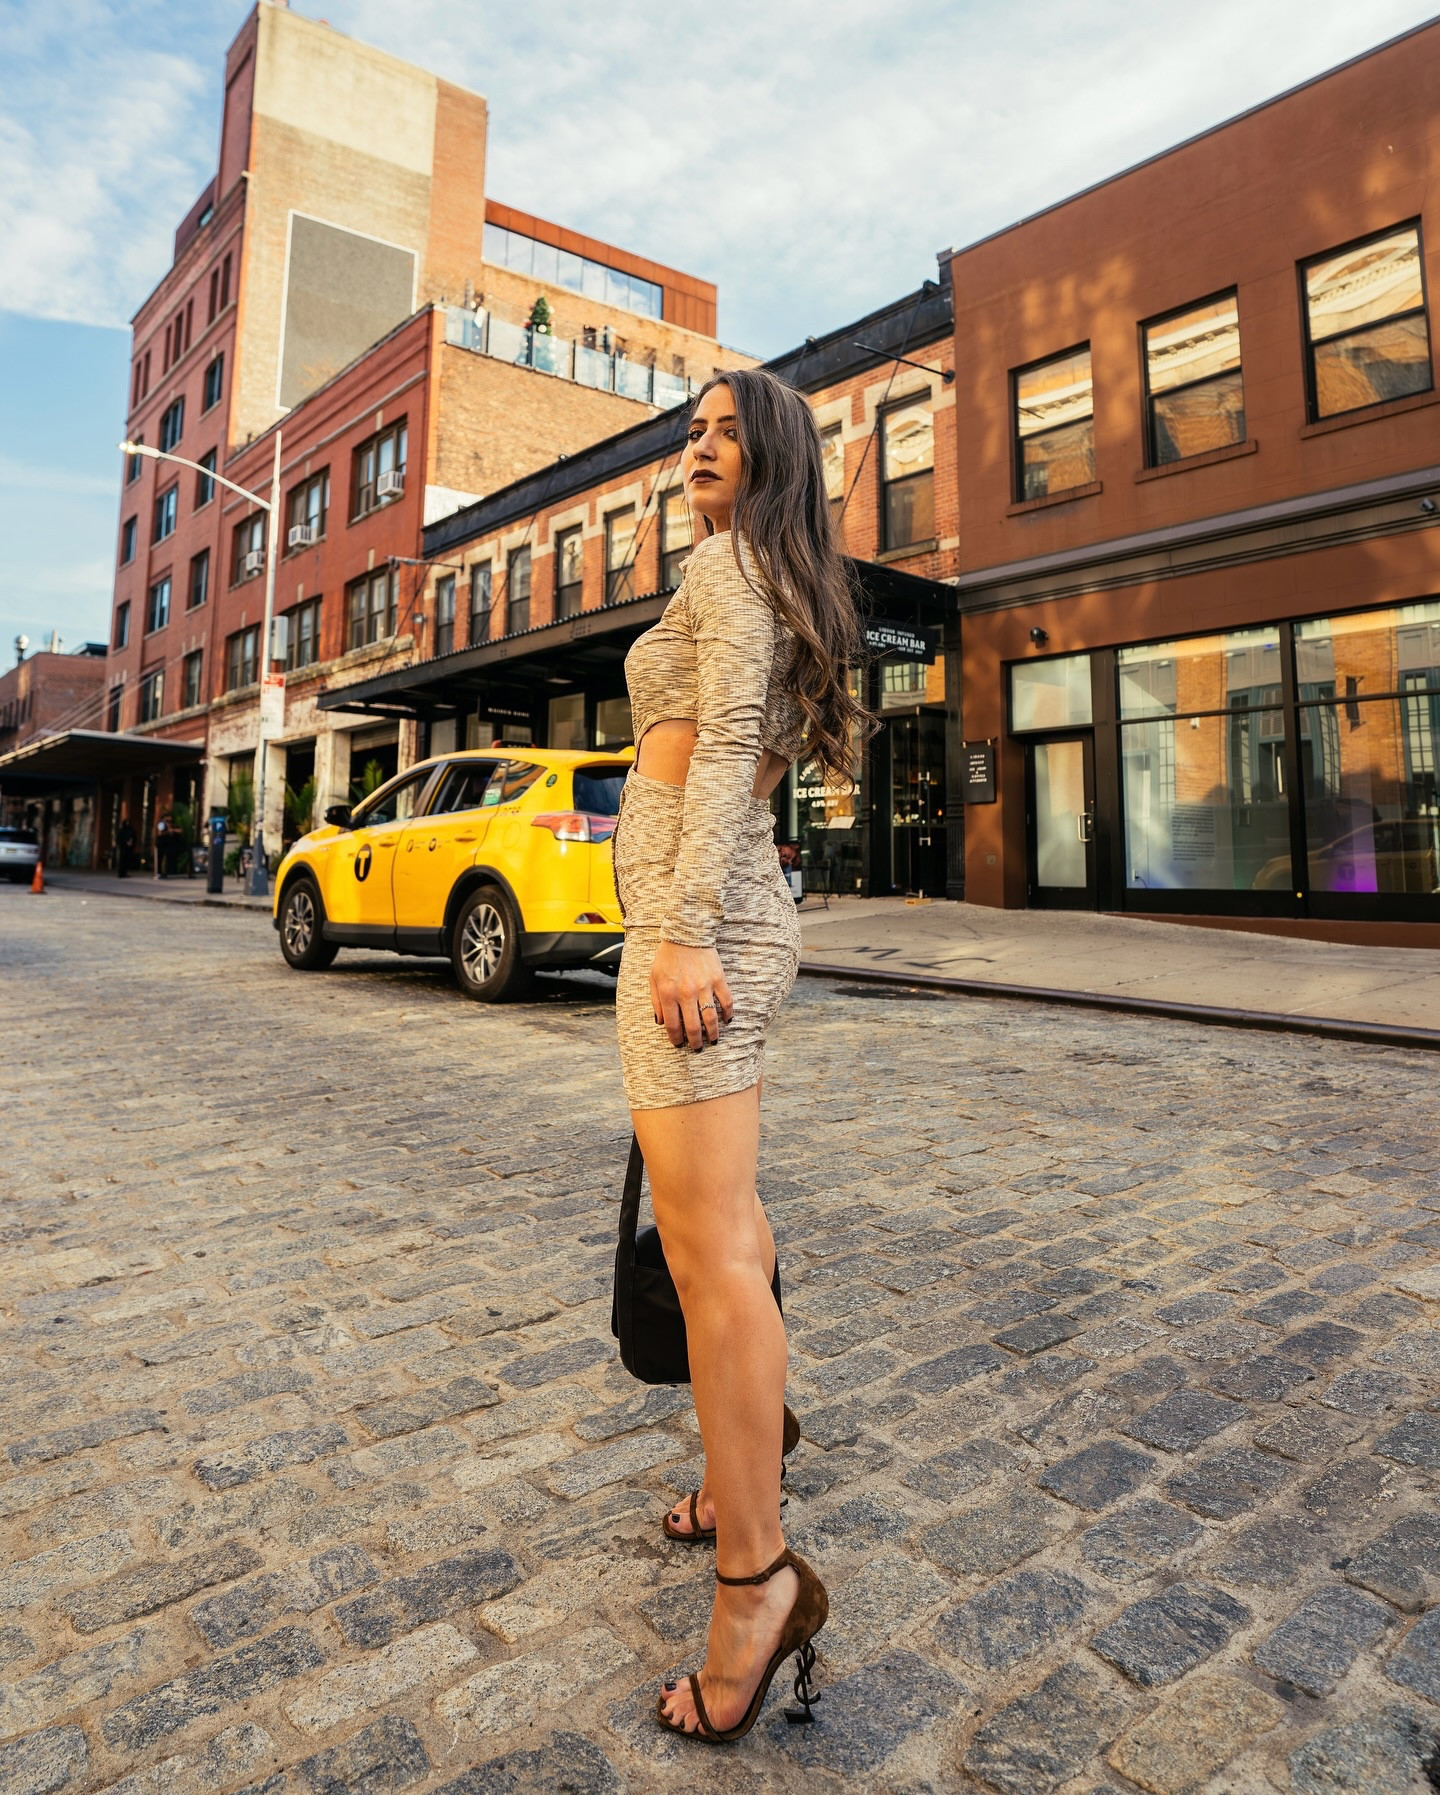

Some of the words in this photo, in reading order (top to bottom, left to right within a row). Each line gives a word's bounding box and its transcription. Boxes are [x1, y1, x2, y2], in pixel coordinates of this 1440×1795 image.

[866, 630, 880, 641] ICE
[880, 633, 908, 647] CREAM
[909, 638, 926, 650] BAR
[793, 787, 807, 799] ICE
